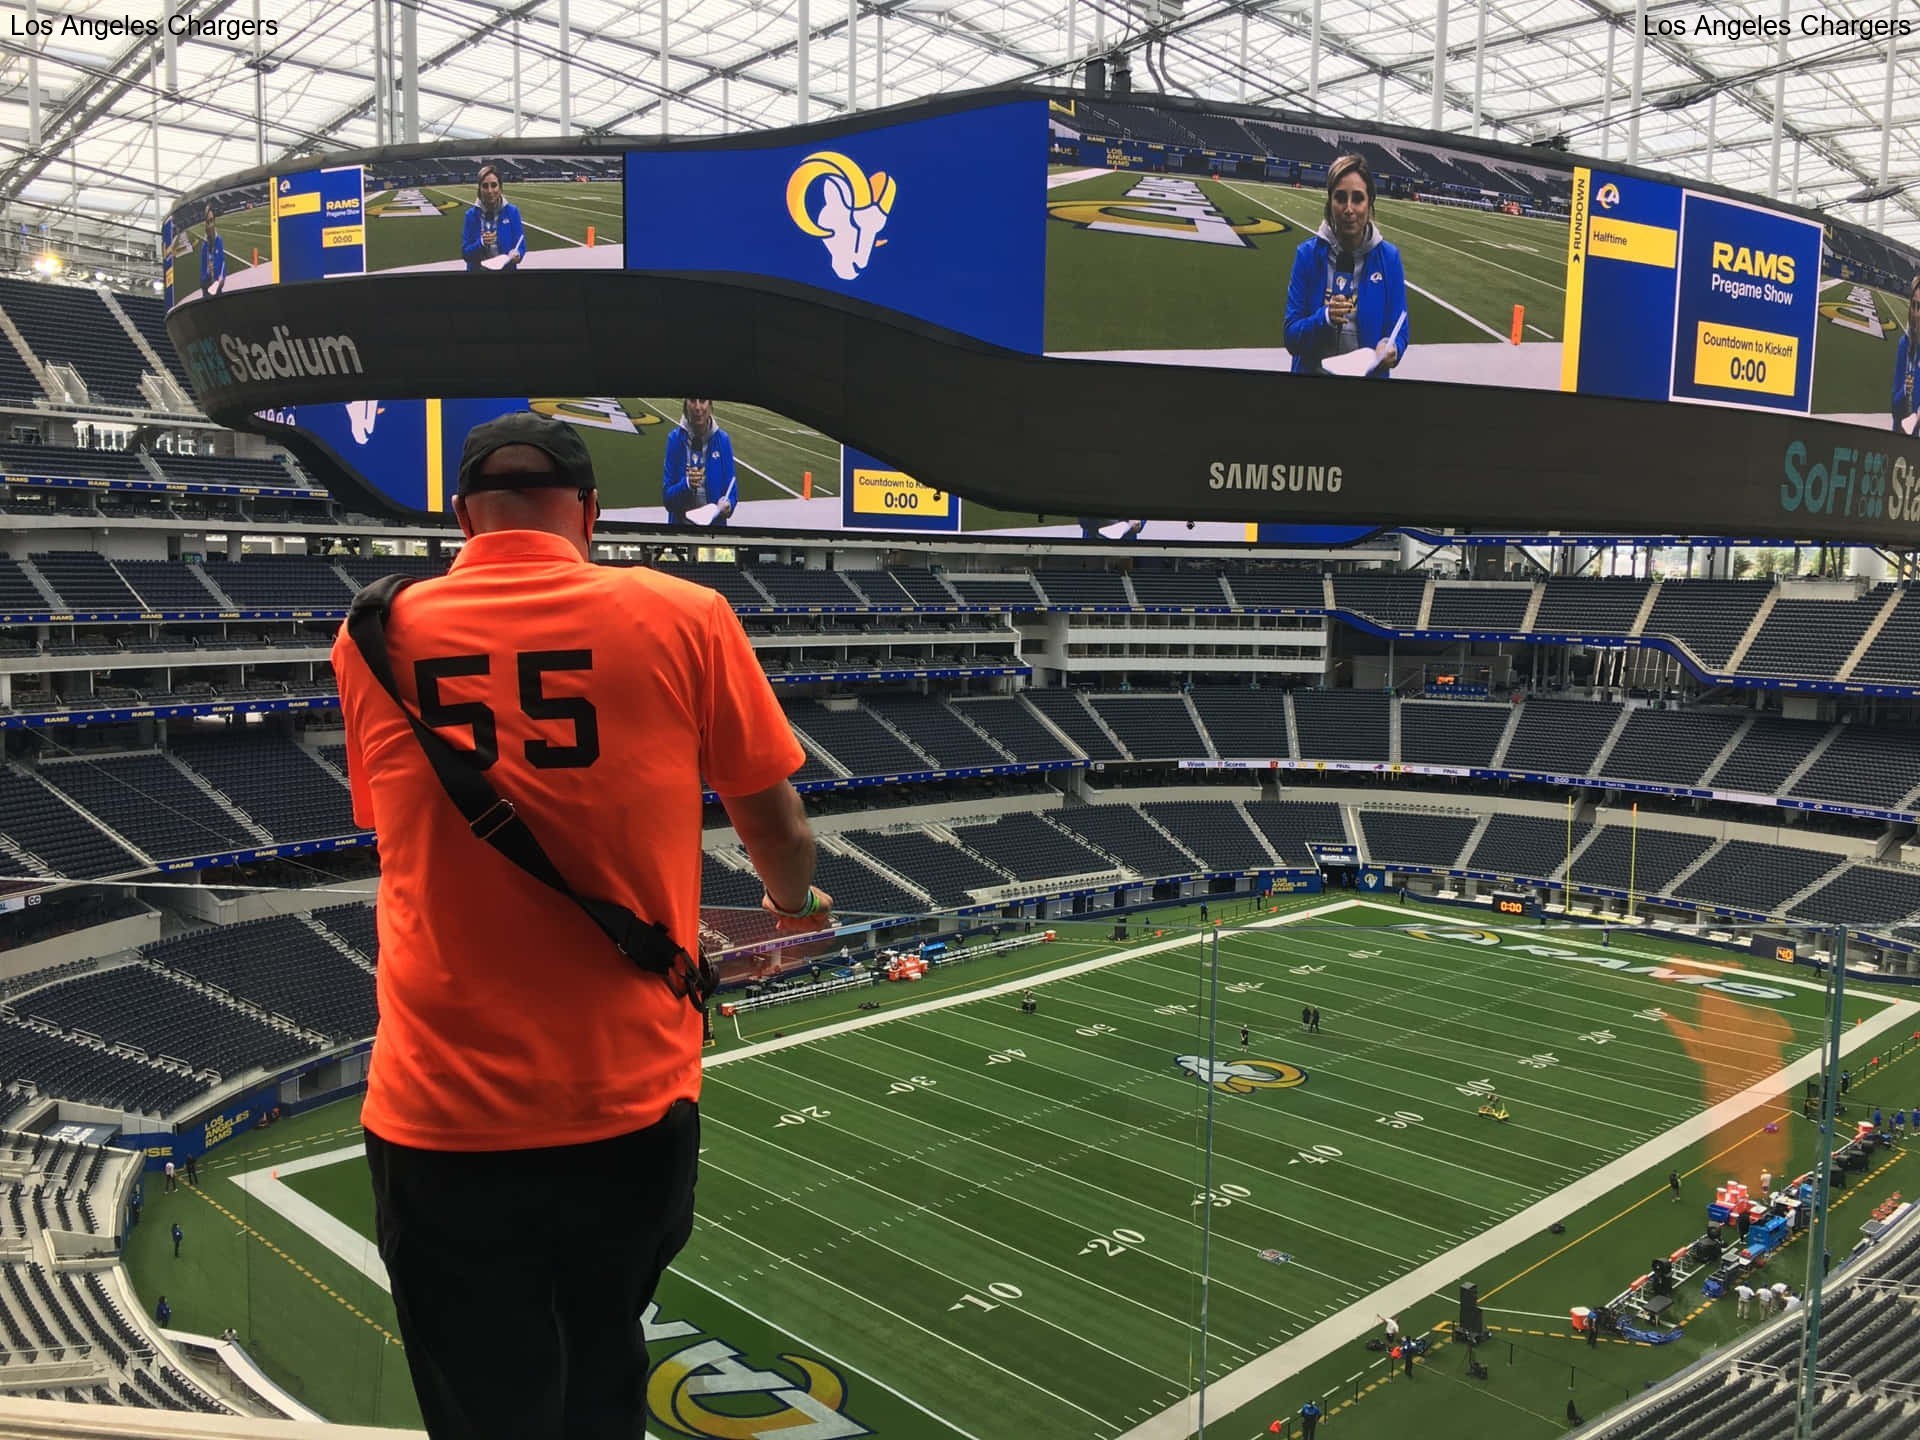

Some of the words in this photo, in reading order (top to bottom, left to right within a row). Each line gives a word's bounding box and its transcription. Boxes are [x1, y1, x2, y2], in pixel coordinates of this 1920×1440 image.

[326, 198, 360, 210] RAMS
[1573, 178, 1585, 250] RUNDOWN
[1592, 231, 1628, 246] Halftime
[1713, 241, 1796, 285] RAMS
[1711, 273, 1762, 299] Pregame
[1764, 284, 1793, 305] Show
[220, 325, 364, 383] Stadium
[1703, 331, 1753, 350] Countdown
[1755, 340, 1763, 353] to
[1764, 343, 1793, 358] Kickoff
[1731, 357, 1767, 384] 0:00
[858, 476, 905, 488] Countdown
[906, 481, 914, 489] to
[1209, 462, 1343, 492] SAMSUNG
[1780, 440, 1859, 517] SoFi
[884, 492, 918, 509] 0:00
[413, 649, 600, 772] 55
[1500, 901, 1522, 913] 0:00
[1501, 944, 1797, 999] RAMS
[889, 1075, 937, 1093] 30
[1455, 1080, 1496, 1096] 40
[205, 1114, 225, 1130] LOS
[206, 1110, 249, 1139] ANGELES
[780, 1105, 831, 1125] 20
[1376, 1110, 1424, 1129] 50
[205, 1127, 233, 1149] RAMS
[1298, 1144, 1343, 1164] 40
[1197, 1183, 1251, 1207] 30
[1087, 1228, 1145, 1257] 20
[960, 1282, 1023, 1312] 10
